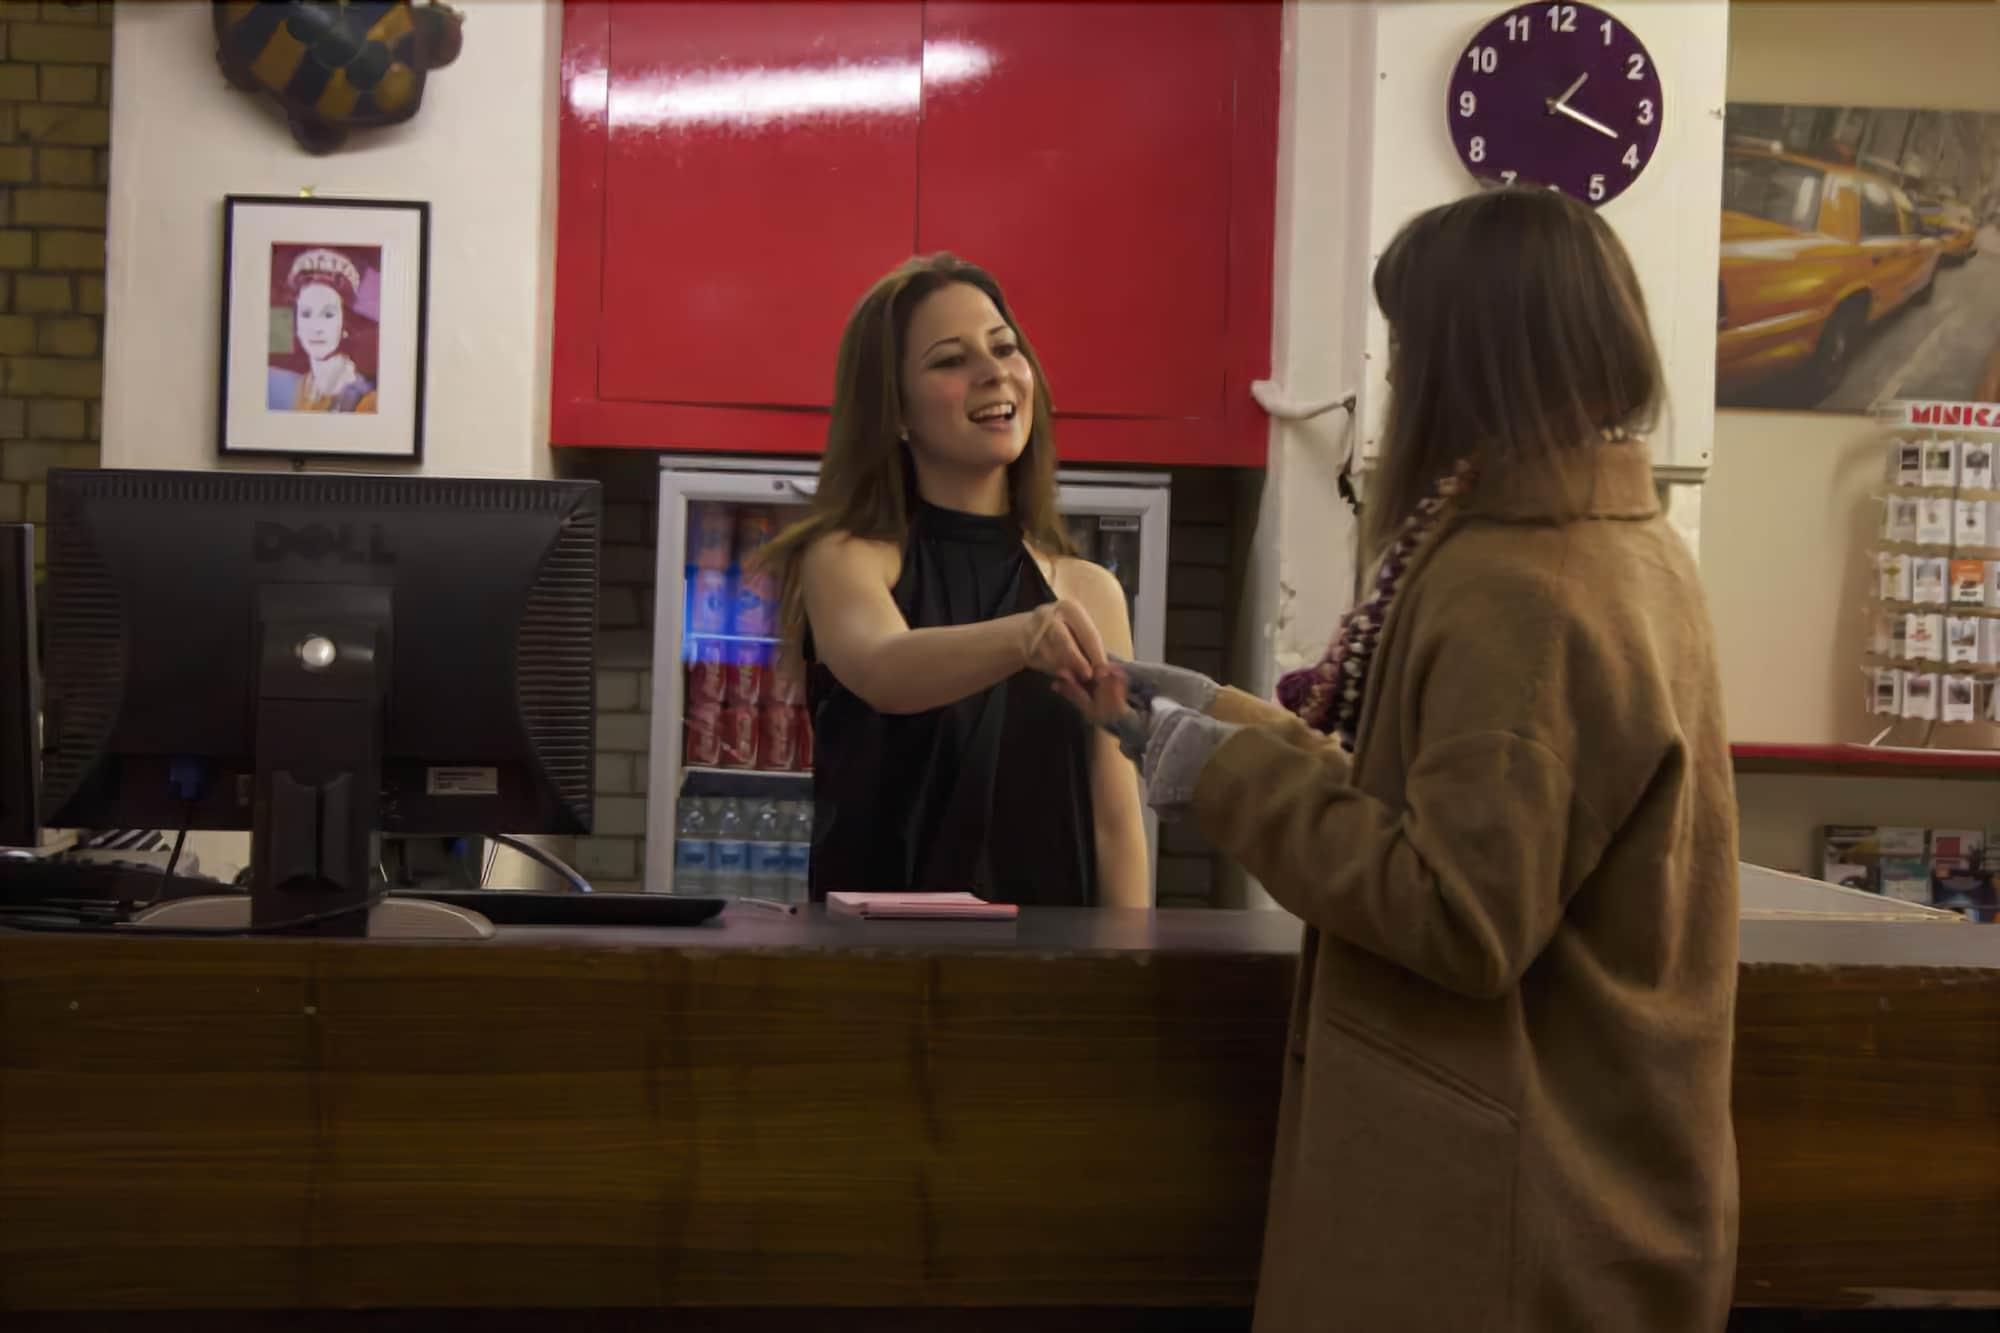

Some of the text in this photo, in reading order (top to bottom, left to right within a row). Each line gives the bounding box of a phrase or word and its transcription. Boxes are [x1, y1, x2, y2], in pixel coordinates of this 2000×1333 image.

[1504, 15, 1530, 41] 11
[1547, 5, 1577, 32] 12
[1600, 19, 1612, 45] 1
[1468, 46, 1497, 73] 10
[1627, 53, 1645, 80] 2
[1460, 90, 1477, 117] 9
[1637, 99, 1654, 125] 3
[1469, 136, 1486, 162] 8
[1621, 143, 1640, 170] 4
[1588, 174, 1606, 200] 5
